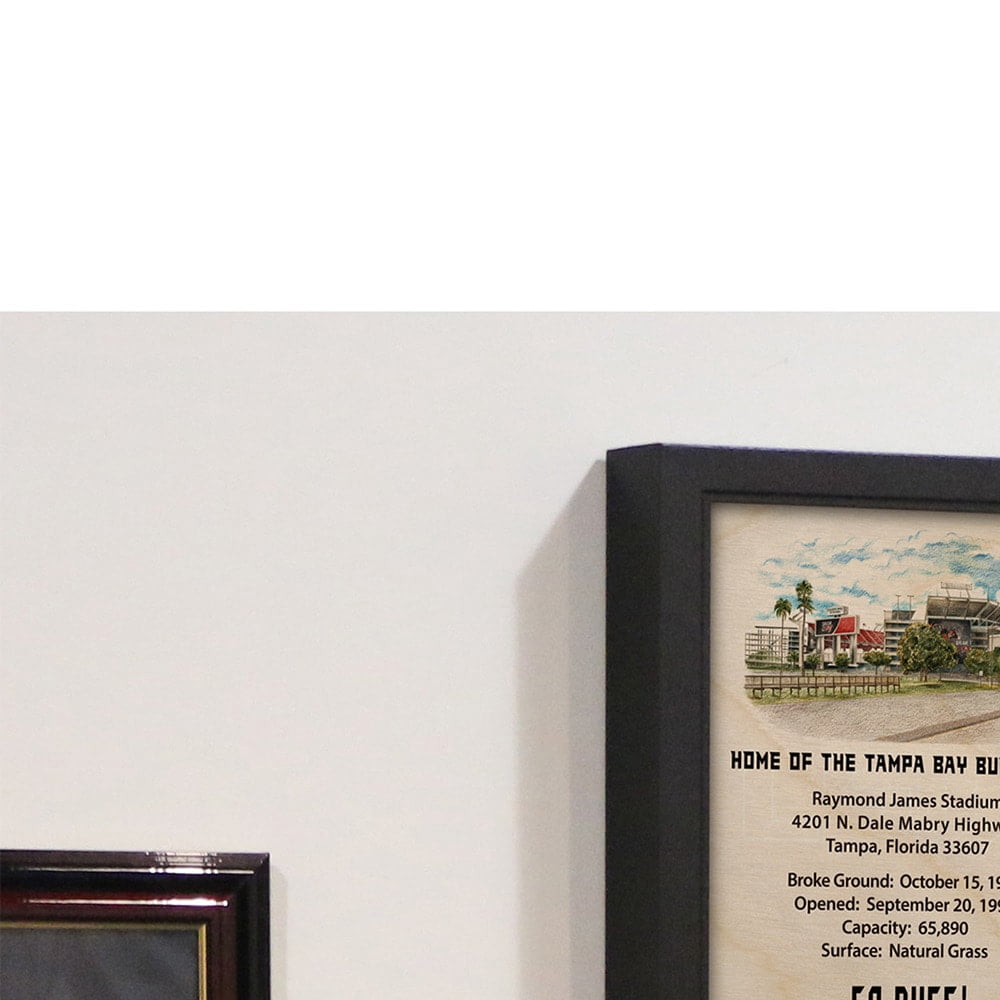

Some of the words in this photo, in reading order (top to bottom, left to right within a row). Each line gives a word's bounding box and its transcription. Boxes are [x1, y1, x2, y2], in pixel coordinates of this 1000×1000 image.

[730, 750, 781, 770] HOME
[789, 751, 813, 771] OF
[820, 752, 856, 772] THE
[864, 753, 925, 774] TAMPA
[932, 755, 968, 775] BAY
[812, 790, 886, 810] Raymond
[889, 792, 937, 808] James
[791, 814, 829, 829] 4201
[836, 814, 853, 830] N.
[858, 814, 894, 831] Dale
[898, 815, 950, 836] Mabry
[825, 837, 882, 857] Tampa,
[886, 838, 939, 855] Florida
[942, 840, 990, 855] 33607
[787, 871, 831, 888] Broke
[833, 872, 894, 889] Ground:
[899, 873, 960, 890] October
[963, 875, 984, 892] 15,
[794, 895, 860, 915] Opened:
[866, 896, 951, 916] September
[952, 898, 976, 915] 20,
[841, 919, 912, 939] Capacity:
[918, 920, 969, 938] 65,890
[821, 942, 882, 958] Surface:
[889, 943, 944, 959] Natural
[947, 943, 989, 959] Grass
